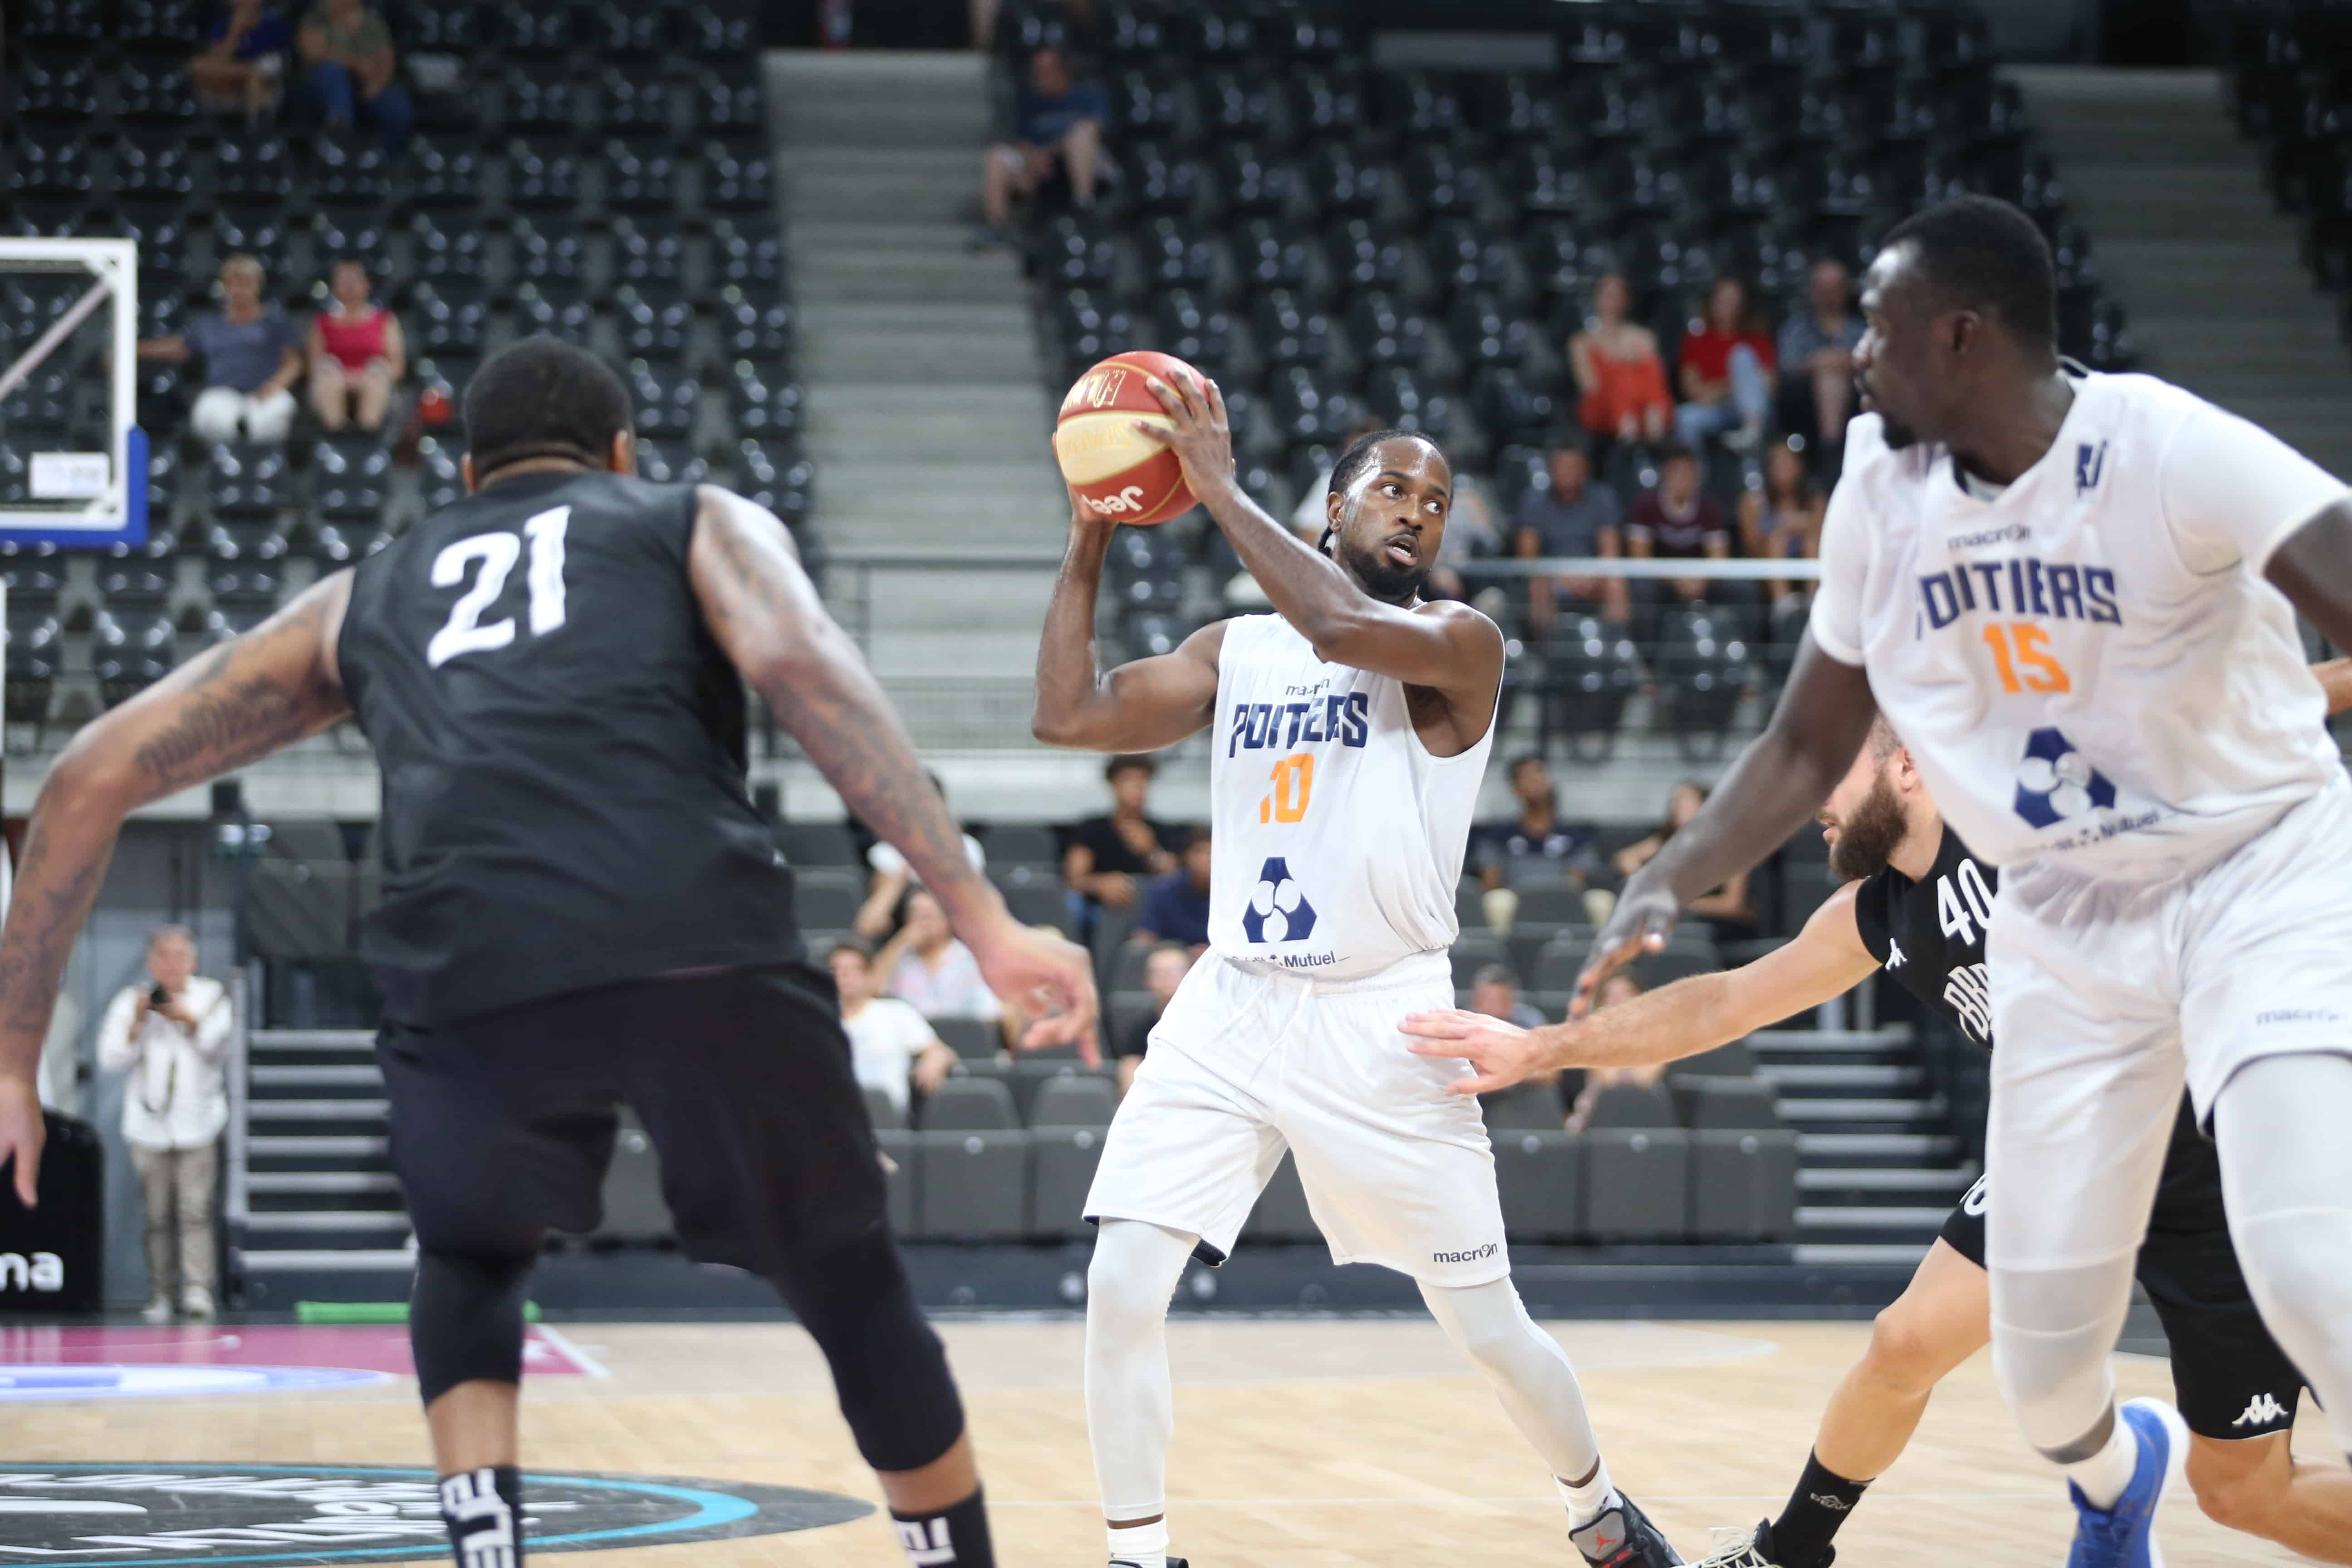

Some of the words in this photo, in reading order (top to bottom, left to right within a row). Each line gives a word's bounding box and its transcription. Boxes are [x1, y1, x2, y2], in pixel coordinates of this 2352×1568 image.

[426, 505, 572, 669] 21
[1916, 558, 2123, 641] OITIERS
[1983, 623, 2071, 694] 15
[1259, 753, 1314, 823] 10
[1937, 858, 1993, 945] 40
[1284, 951, 1336, 967] Mutuel
[1433, 1243, 1498, 1263] macron
